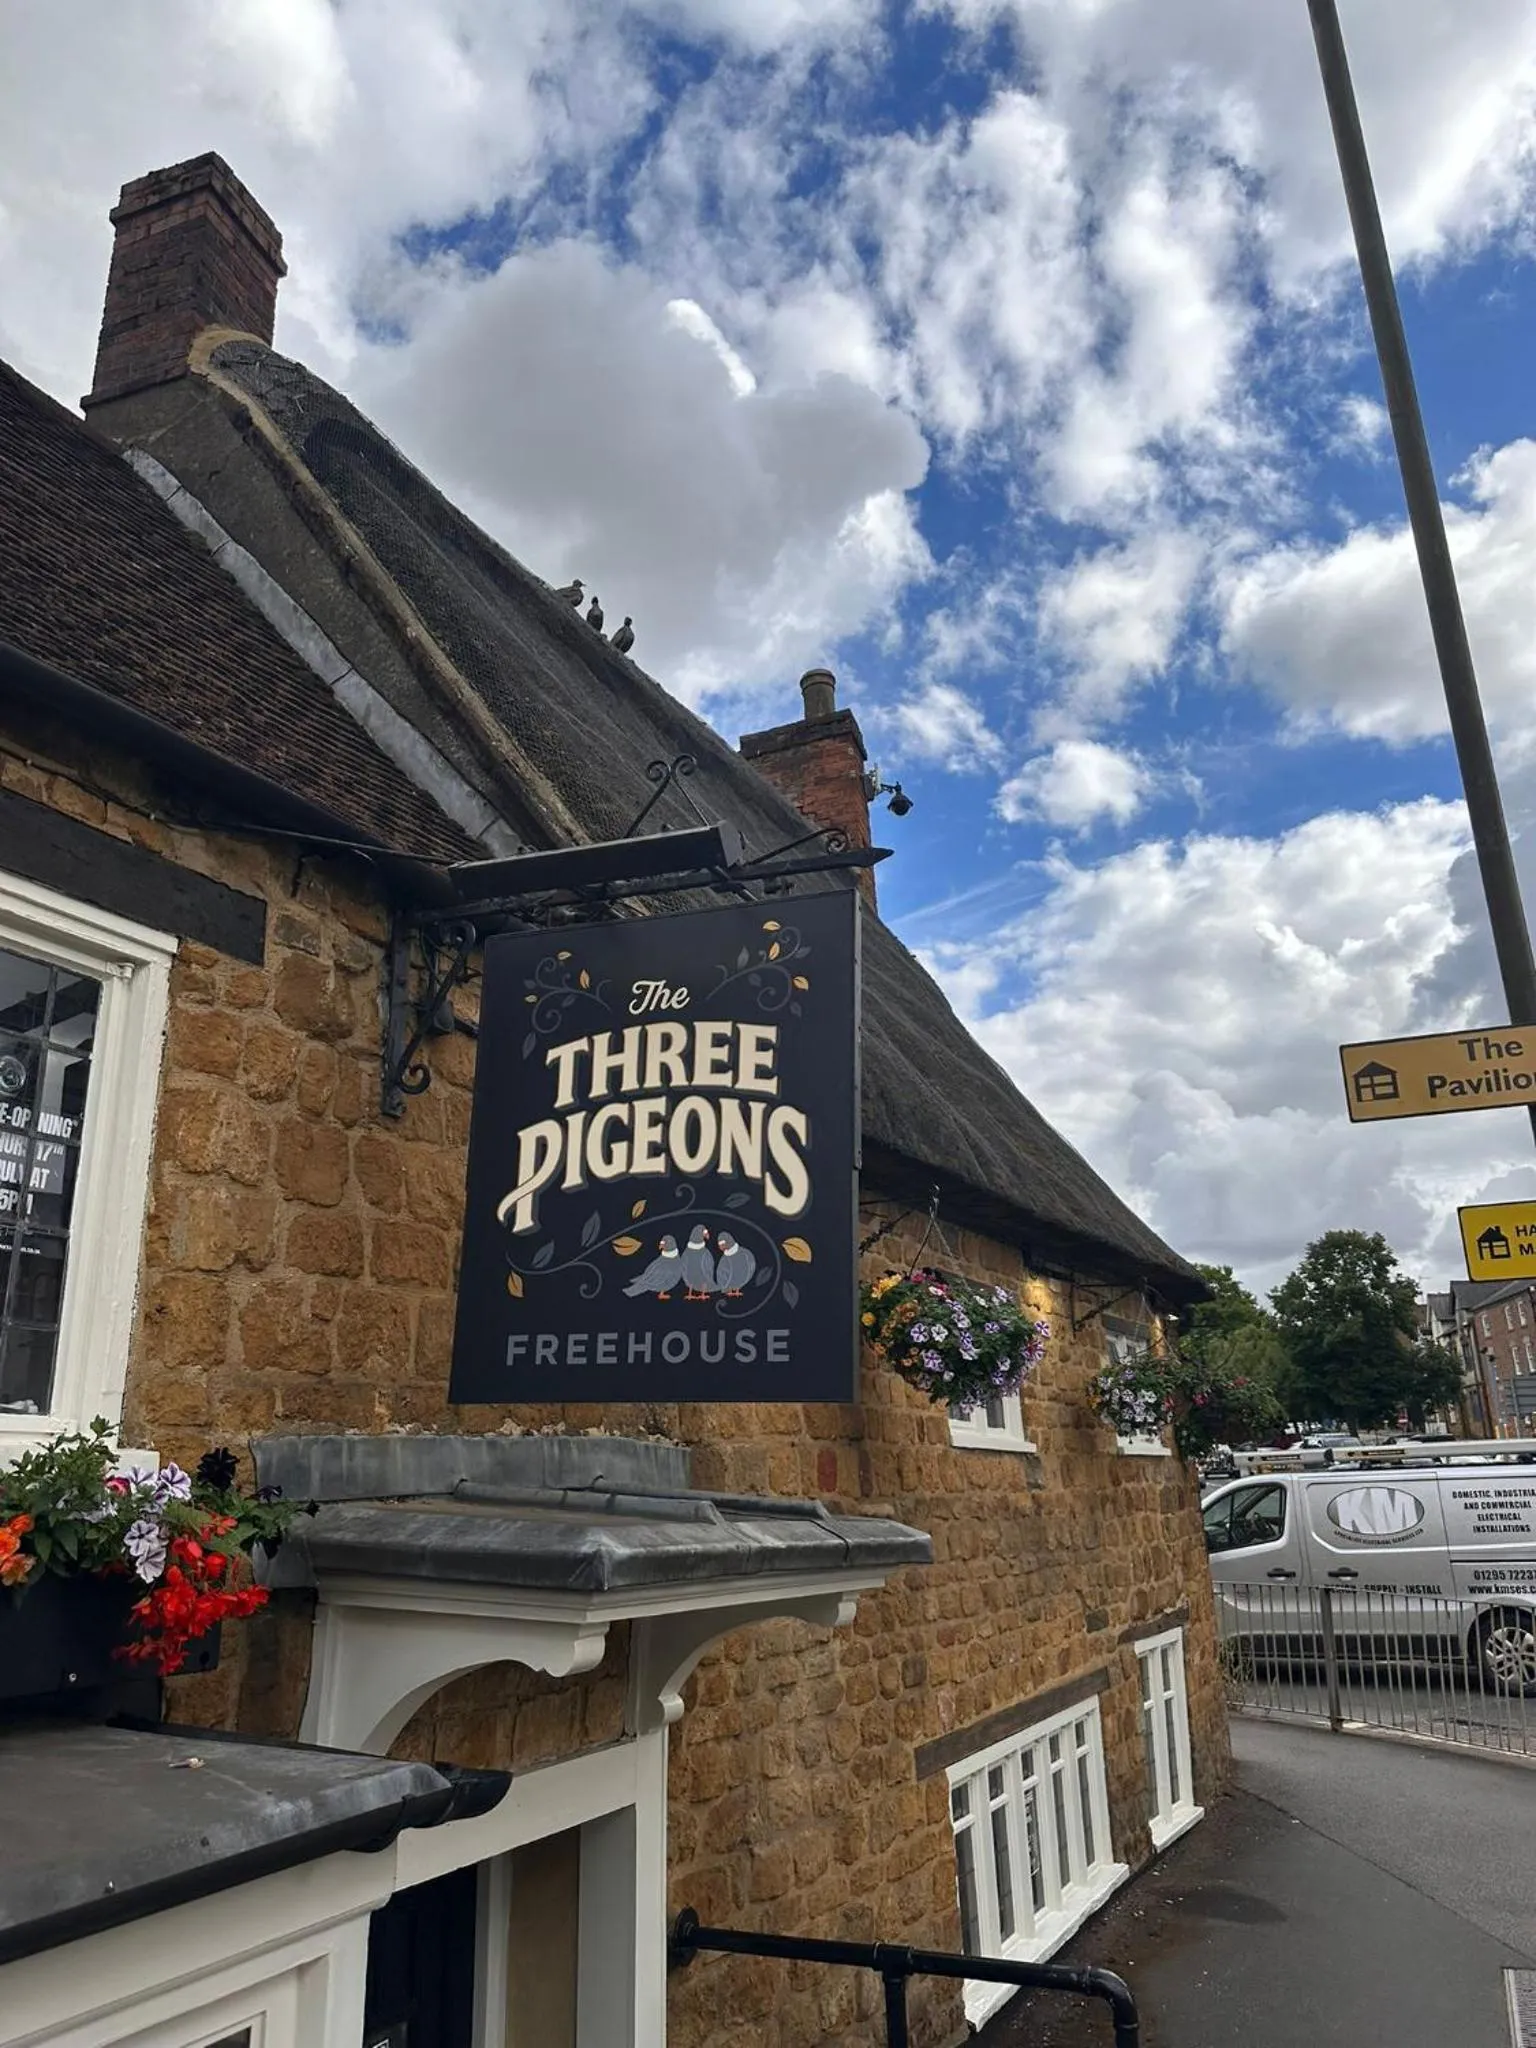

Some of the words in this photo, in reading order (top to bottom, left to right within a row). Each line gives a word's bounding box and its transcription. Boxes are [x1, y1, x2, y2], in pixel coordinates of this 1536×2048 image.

[628, 979, 691, 1016] The
[1458, 1036, 1524, 1061] The
[545, 1019, 780, 1109] THREE
[1427, 1067, 1536, 1099] Pavilio
[496, 1094, 811, 1234] PIGEONS
[29, 1167, 50, 1189] AT
[505, 1328, 791, 1366] FREEHOUSE
[1337, 1487, 1419, 1534] KM
[1464, 1502, 1479, 1510] AND
[1481, 1501, 1532, 1510] COMMERCIAL
[1477, 1513, 1522, 1521] ELECTRICAL
[1473, 1525, 1531, 1533] INSTALLATIONS
[1474, 1570, 1506, 1580] 01295
[1405, 1585, 1442, 1594] INSTALL
